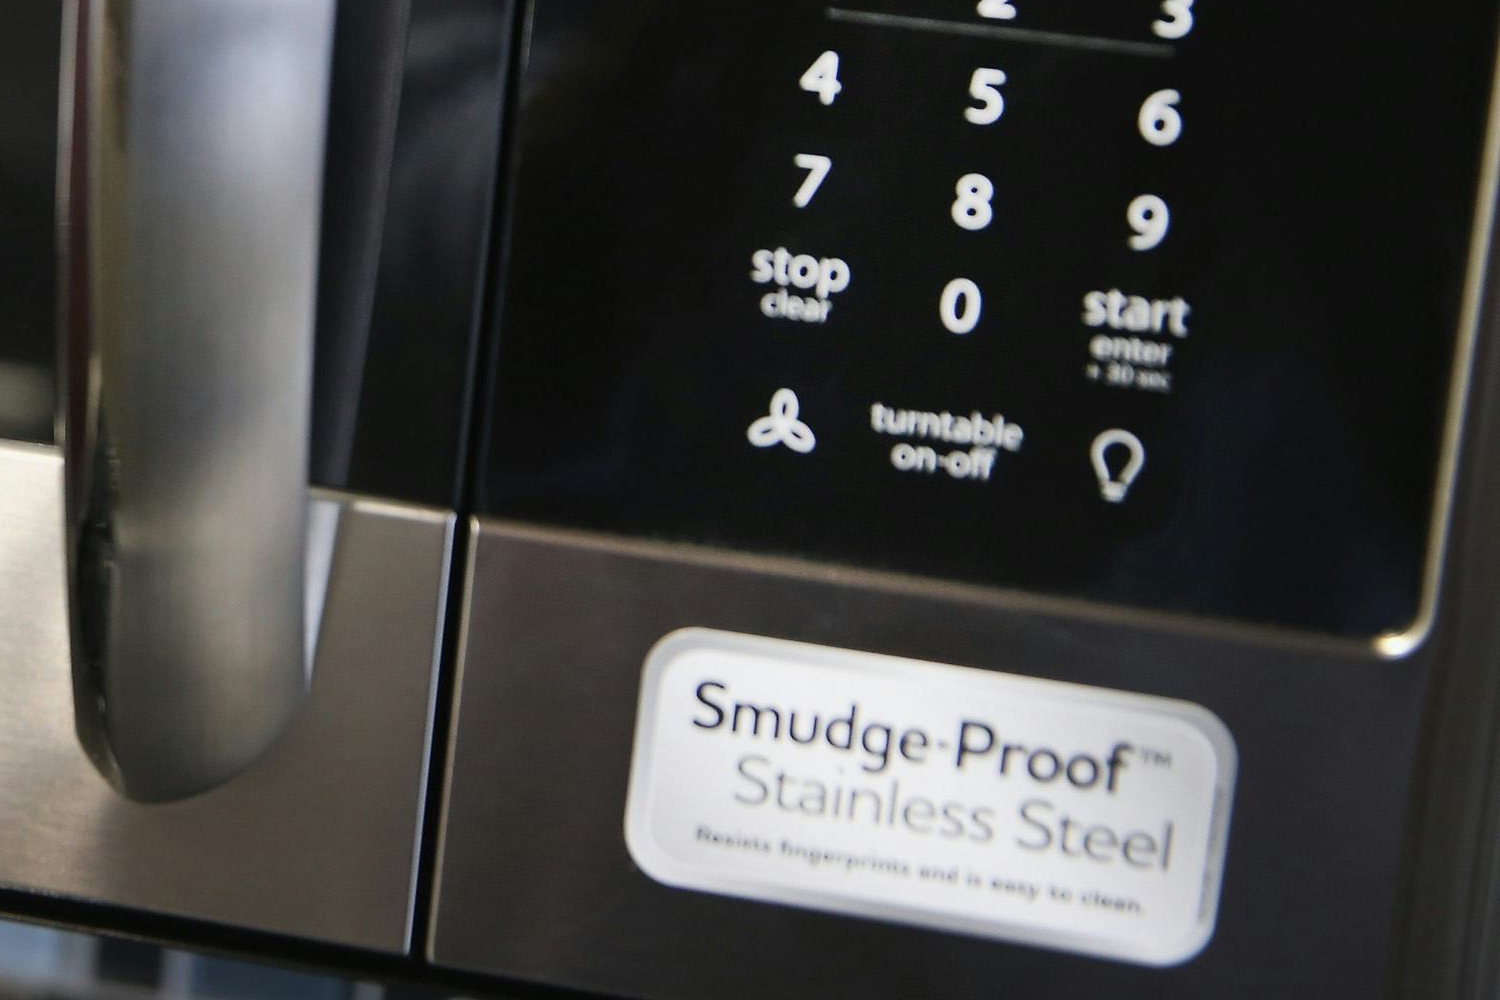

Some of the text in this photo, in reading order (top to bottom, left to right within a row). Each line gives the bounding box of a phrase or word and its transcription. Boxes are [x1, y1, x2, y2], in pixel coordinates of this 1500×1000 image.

[799, 50, 1182, 147] 4 5 6
[793, 153, 1170, 251] 7 8 9
[751, 246, 851, 299] stop
[759, 288, 833, 324] clear
[939, 277, 982, 335] 0
[1082, 288, 1191, 338] start
[1089, 334, 1173, 366] enter
[870, 402, 1025, 451] turntable
[732, 753, 1176, 873] Stainless Steel
[778, 838, 911, 878] fingerprints
[919, 863, 960, 885] and
[990, 879, 1042, 902] easy
[1049, 886, 1073, 903] to
